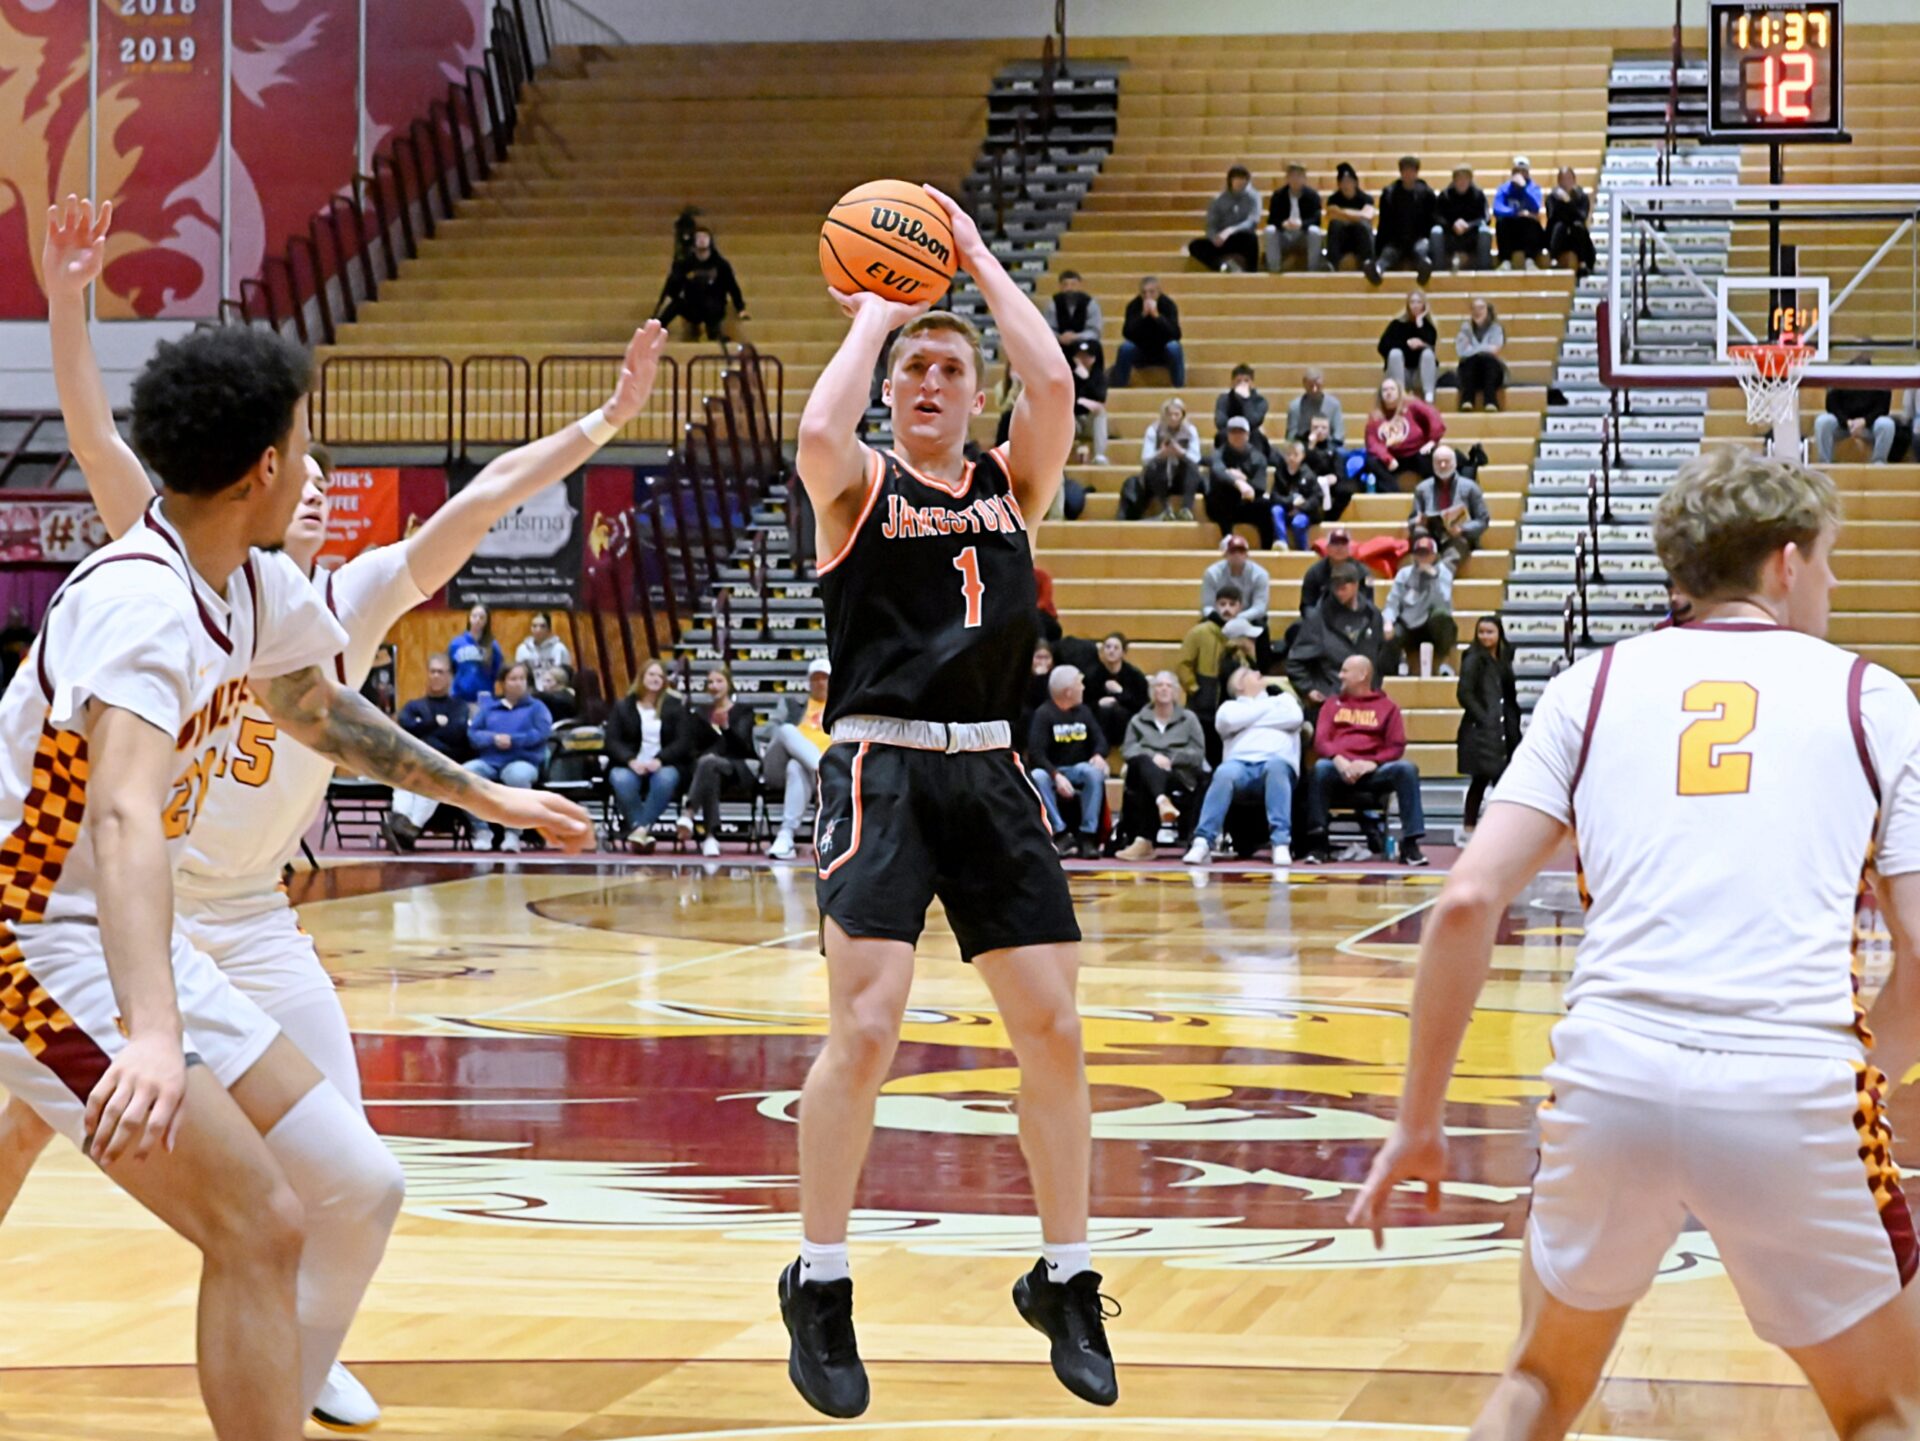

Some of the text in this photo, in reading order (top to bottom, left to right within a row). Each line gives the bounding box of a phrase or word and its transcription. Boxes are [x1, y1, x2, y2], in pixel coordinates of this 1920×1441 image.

[120, 36, 196, 62] 2019
[1738, 12, 1827, 50] 11:37
[1763, 53, 1814, 118] 12
[870, 206, 950, 267] Wilson
[491, 508, 566, 532] arisma
[881, 489, 1027, 540] JAMESTOWN
[953, 546, 985, 628] 1
[1676, 680, 1760, 797] 2
